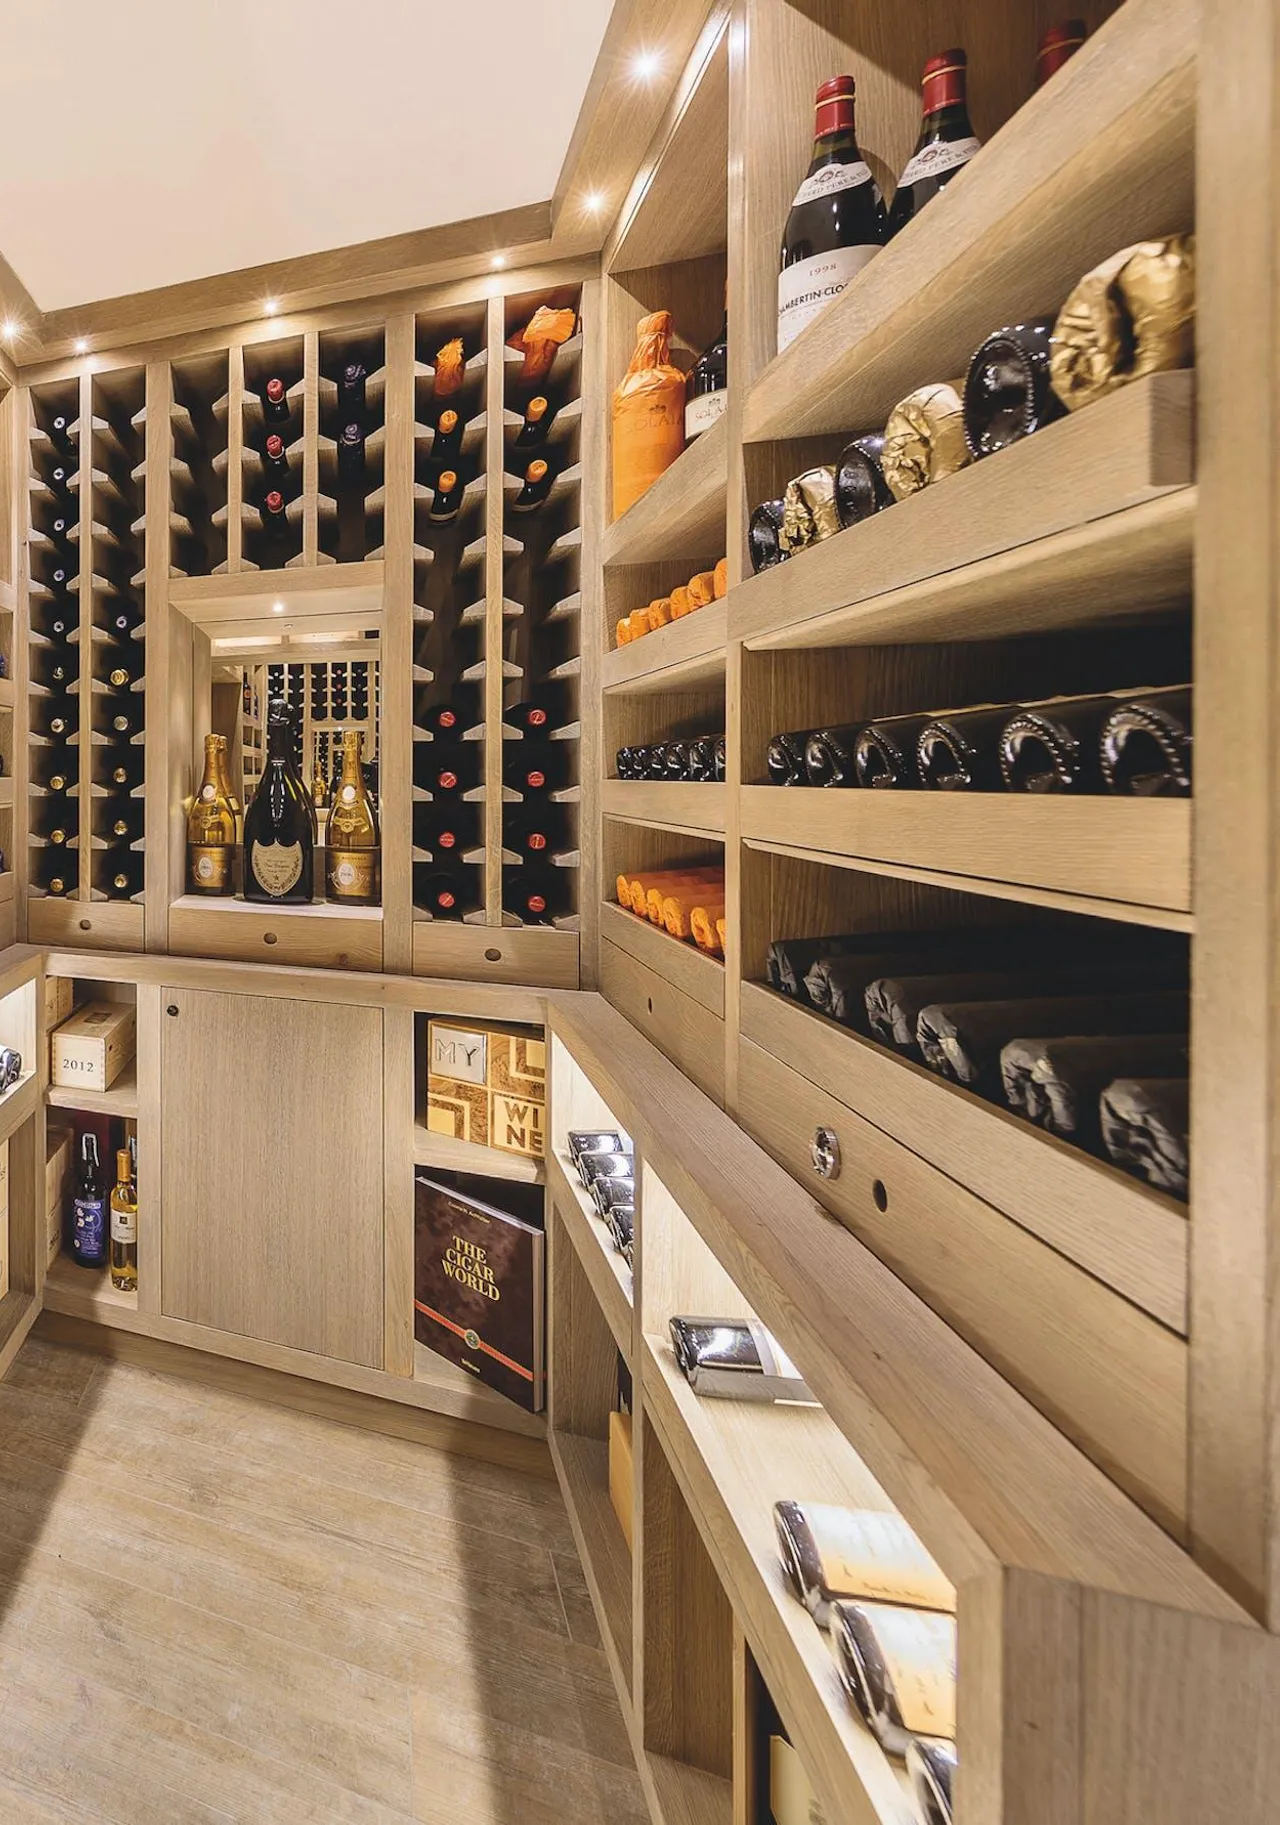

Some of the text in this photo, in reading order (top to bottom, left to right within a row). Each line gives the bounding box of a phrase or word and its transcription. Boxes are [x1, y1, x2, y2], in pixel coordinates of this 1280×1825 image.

[809, 262, 838, 277] 1998
[63, 1058, 94, 1073] 2012
[434, 1038, 480, 1067] MY
[452, 1234, 487, 1264] THE
[441, 1259, 501, 1301] WORLD
[445, 1247, 495, 1285] CIGAR
